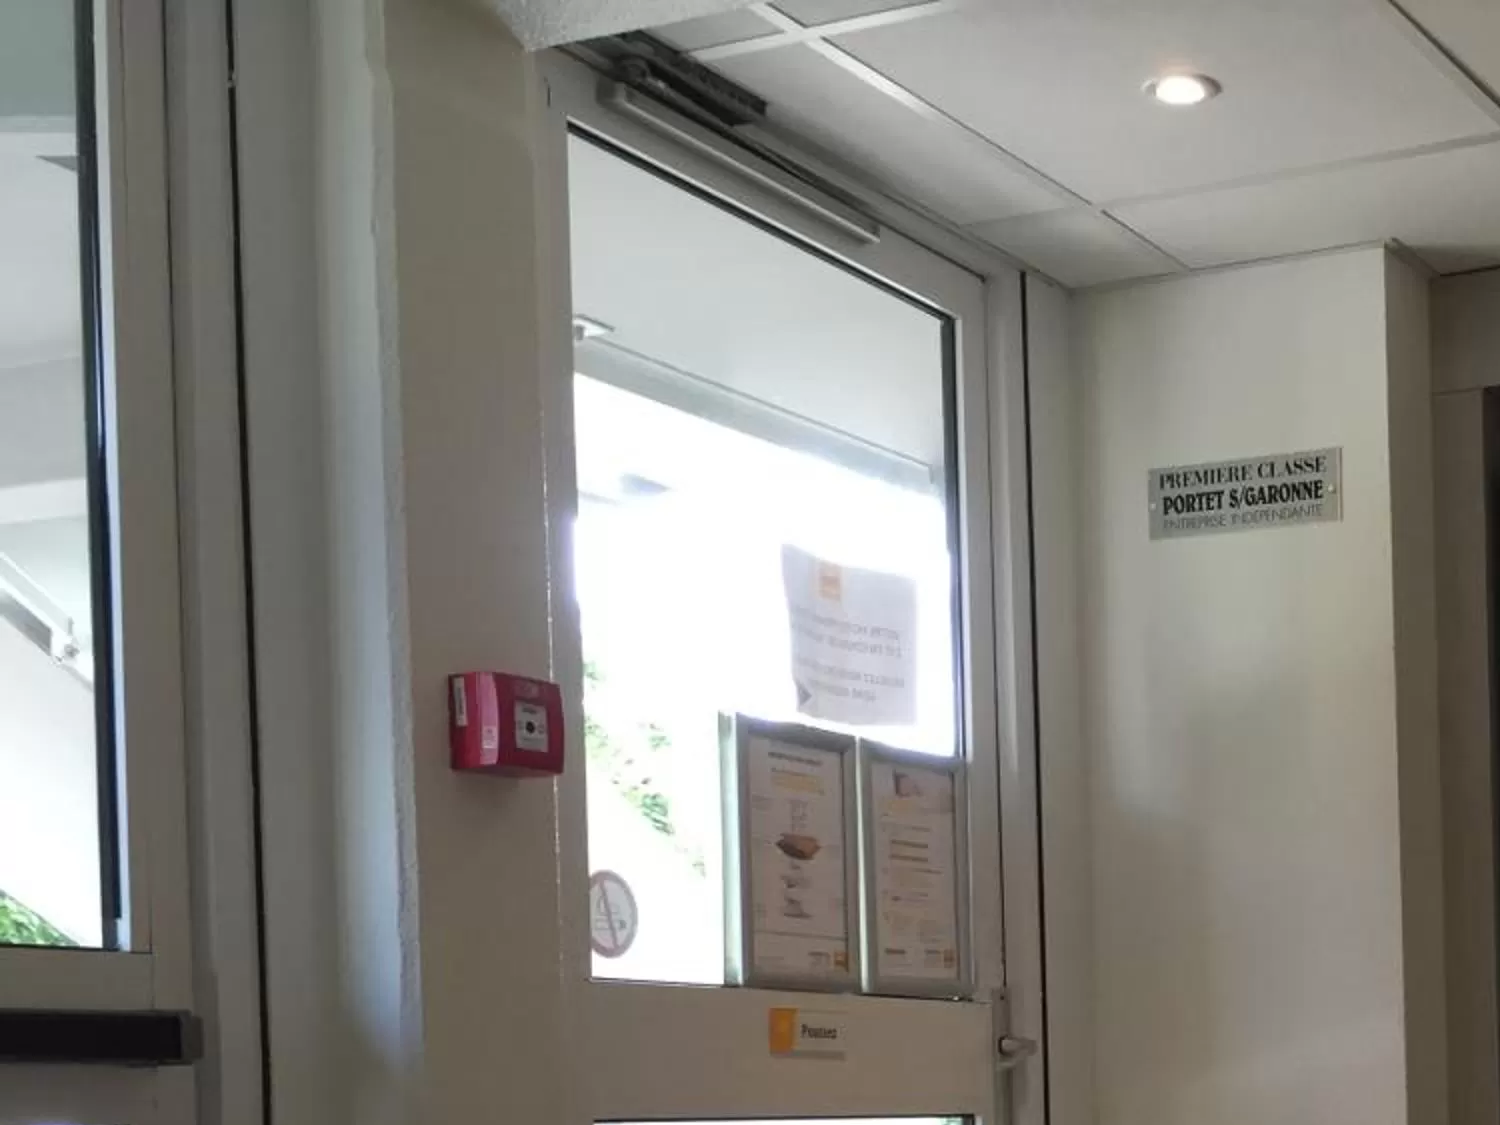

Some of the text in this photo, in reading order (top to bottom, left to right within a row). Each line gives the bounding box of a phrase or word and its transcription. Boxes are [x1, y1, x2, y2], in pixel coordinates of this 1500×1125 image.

[1158, 455, 1328, 491] PREMIERE CLASSE
[1162, 480, 1324, 516] PORTET S/GARONNE
